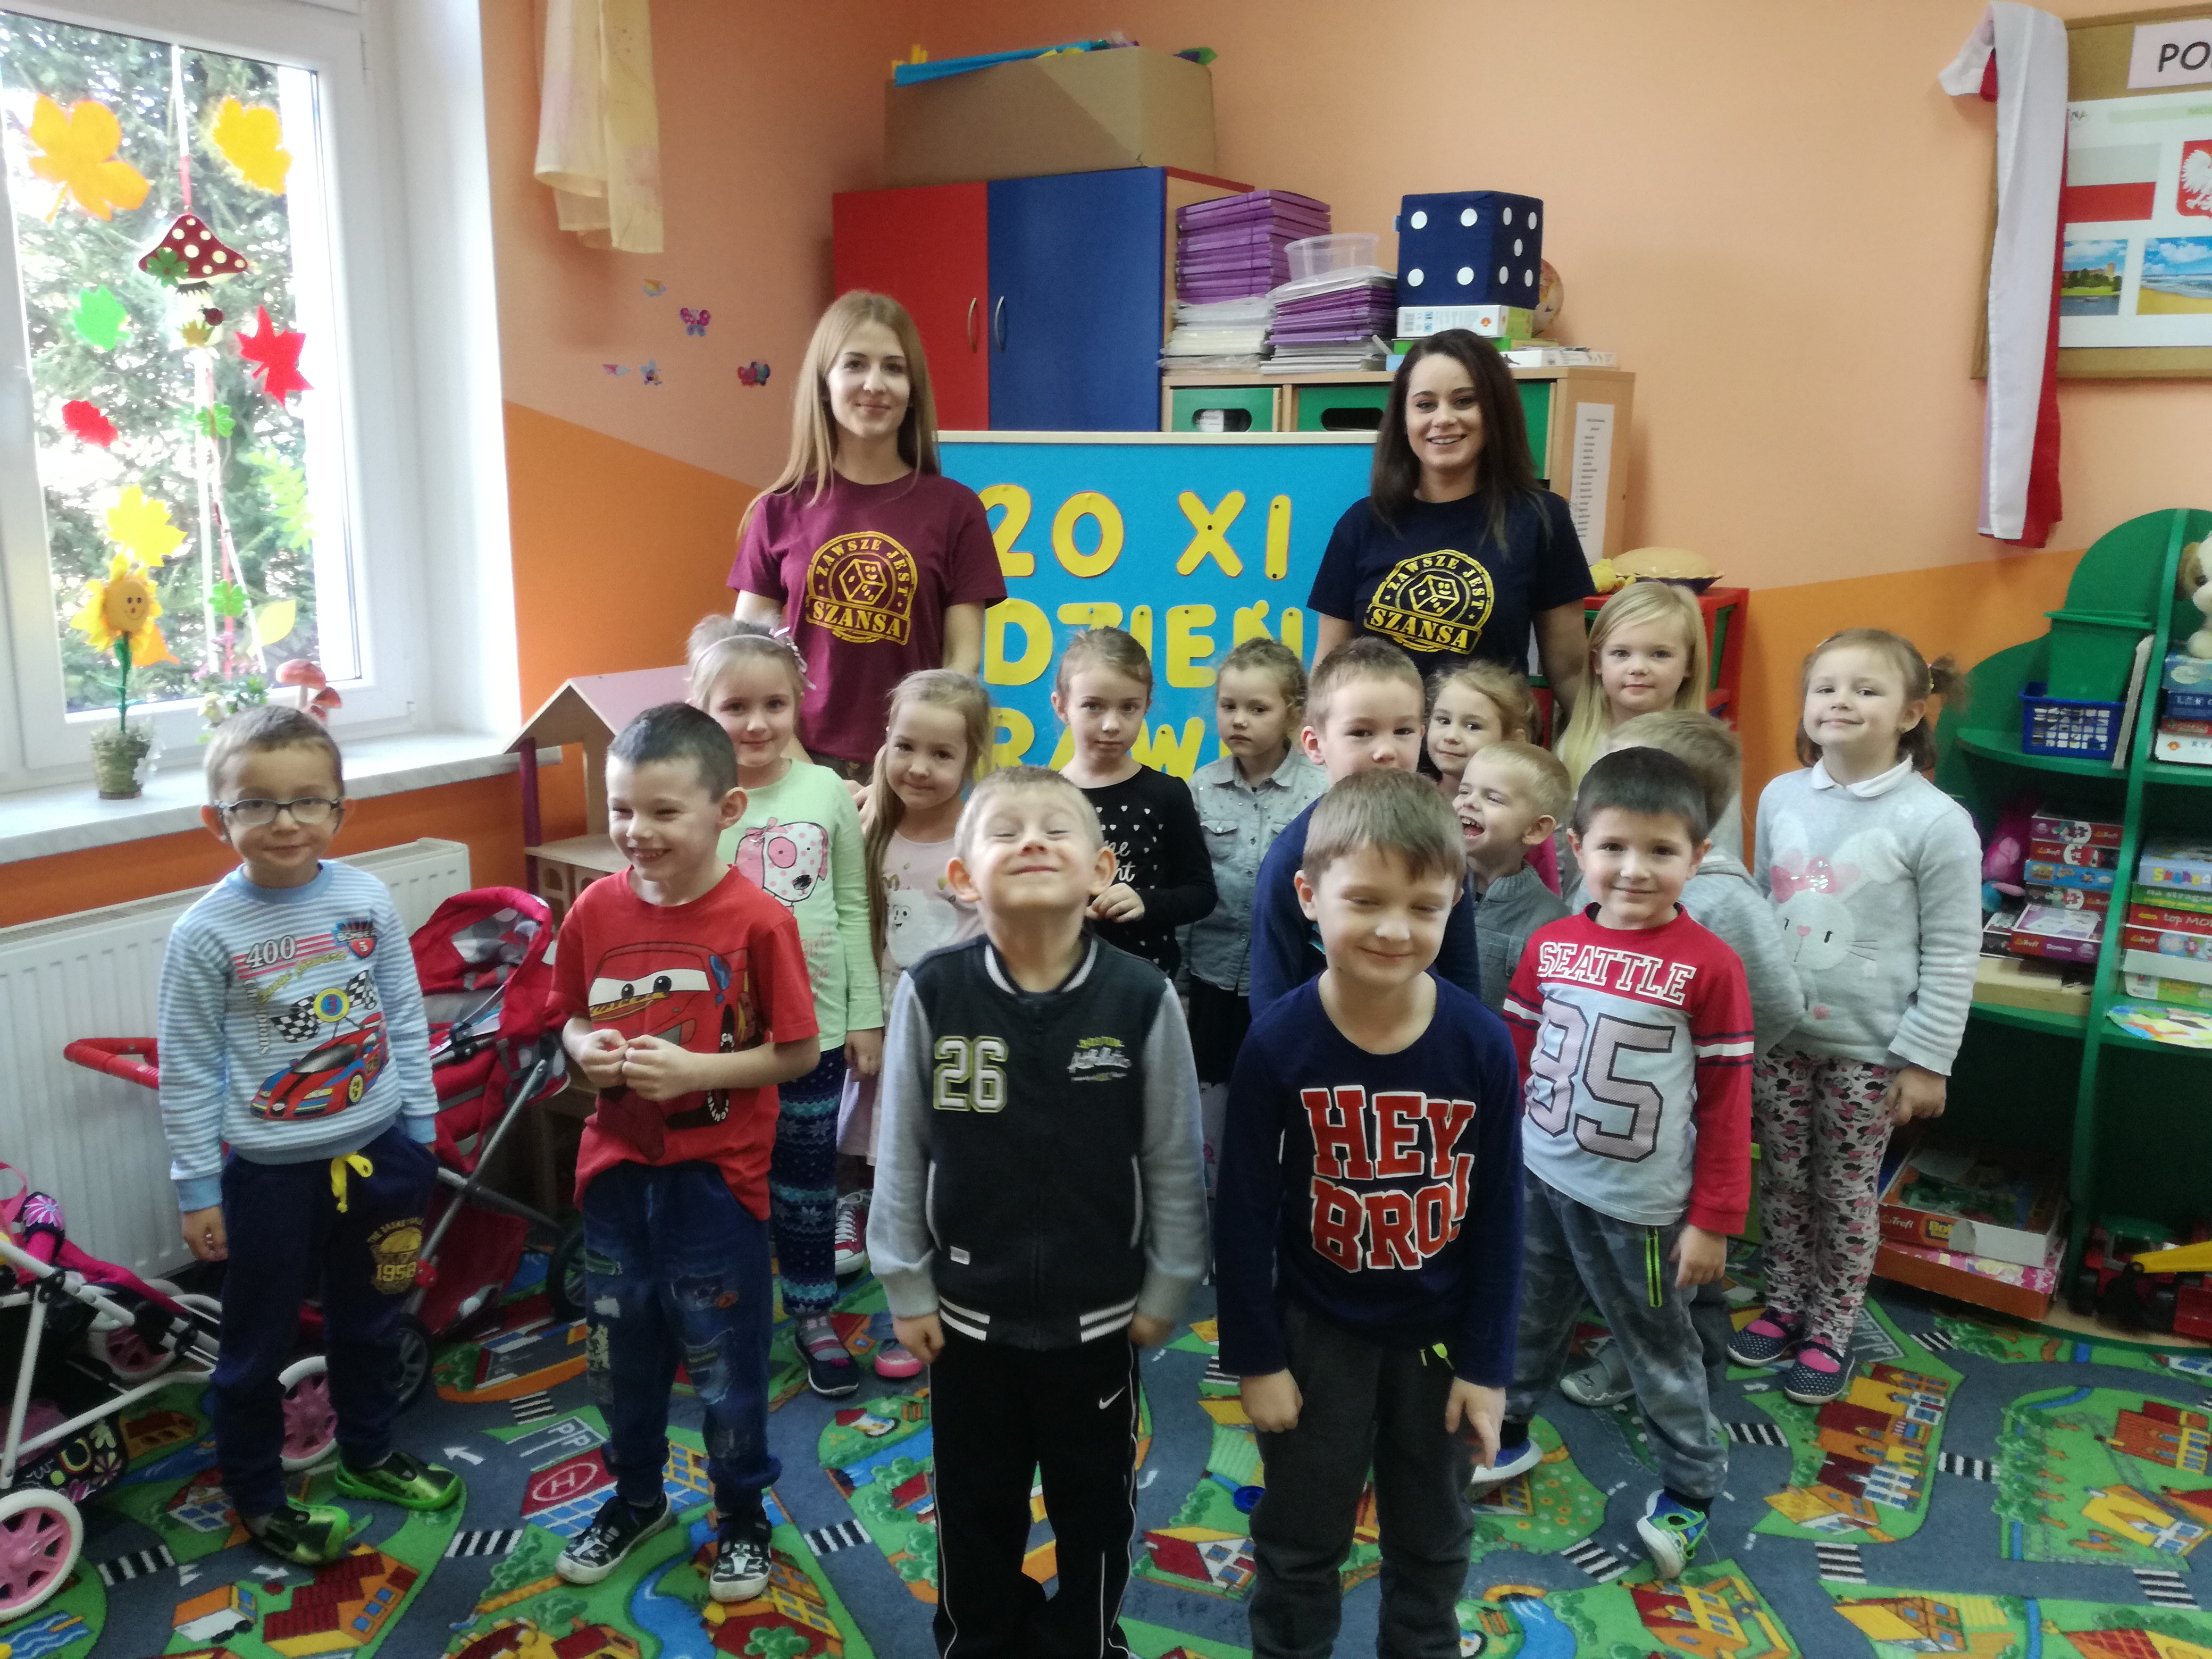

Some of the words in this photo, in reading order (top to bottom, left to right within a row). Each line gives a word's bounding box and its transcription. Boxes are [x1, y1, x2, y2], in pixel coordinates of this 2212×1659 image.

[2158, 41, 2212, 72] PO
[976, 483, 1124, 578] 20
[1176, 490, 1291, 580] XI
[816, 539, 882, 576] ZAWSZE
[886, 550, 910, 597] JEST
[1387, 556, 1460, 590] ZAWSZE
[1463, 569, 1485, 609] JEST
[813, 601, 900, 638] SZANSA
[1370, 608, 1469, 649] SZANSA
[1115, 859, 1136, 882] ht
[245, 935, 297, 969] 400
[1537, 941, 1697, 1006] SEATTLE
[326, 996, 338, 1013] 3
[933, 1035, 1008, 1112] 26
[1300, 1085, 1476, 1180] HEY
[1310, 1153, 1475, 1273] BRO!
[376, 1261, 417, 1282] 1958
[547, 1422, 575, 1434] P
[560, 1435, 591, 1446] P
[551, 1471, 575, 1494] H
